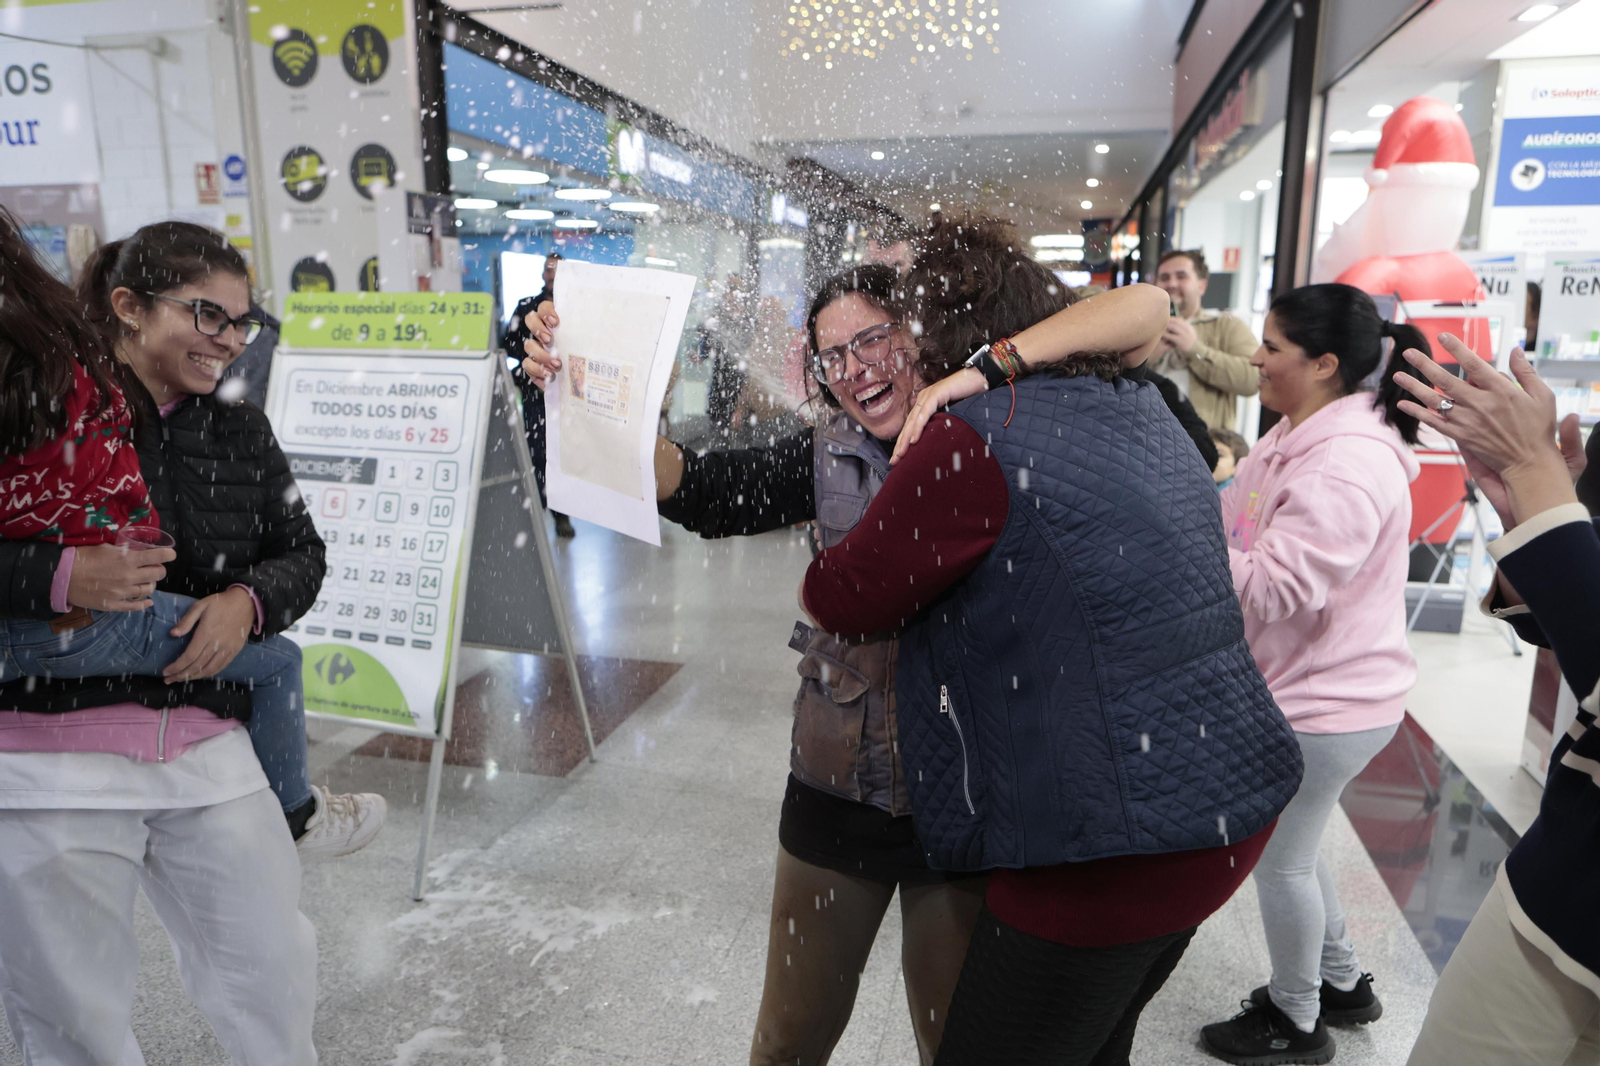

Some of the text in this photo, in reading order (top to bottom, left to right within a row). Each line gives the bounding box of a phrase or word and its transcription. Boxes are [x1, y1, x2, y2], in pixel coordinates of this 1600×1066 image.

[0, 62, 52, 96] OS
[0, 120, 39, 146] ur
[291, 302, 485, 317] Horario especial días 24 y 31:
[331, 324, 432, 342] de 9 a 19h.
[295, 379, 459, 398] En Diciembre ABRIMOS
[311, 401, 438, 420] TODOS LOS DÍAS
[294, 425, 449, 445] excepto los días 6 y 25
[290, 458, 363, 478] DICIEMBRE
[389, 466, 451, 482] 1 2 3
[304, 494, 450, 518] 5 6 7 8 9 10
[322, 530, 444, 553] 13 14 15 16 17
[343, 567, 359, 581] 21
[369, 569, 386, 584] 22
[395, 572, 411, 586] 23
[421, 574, 438, 589] 24
[312, 600, 432, 627] 27 28 29 30 31
